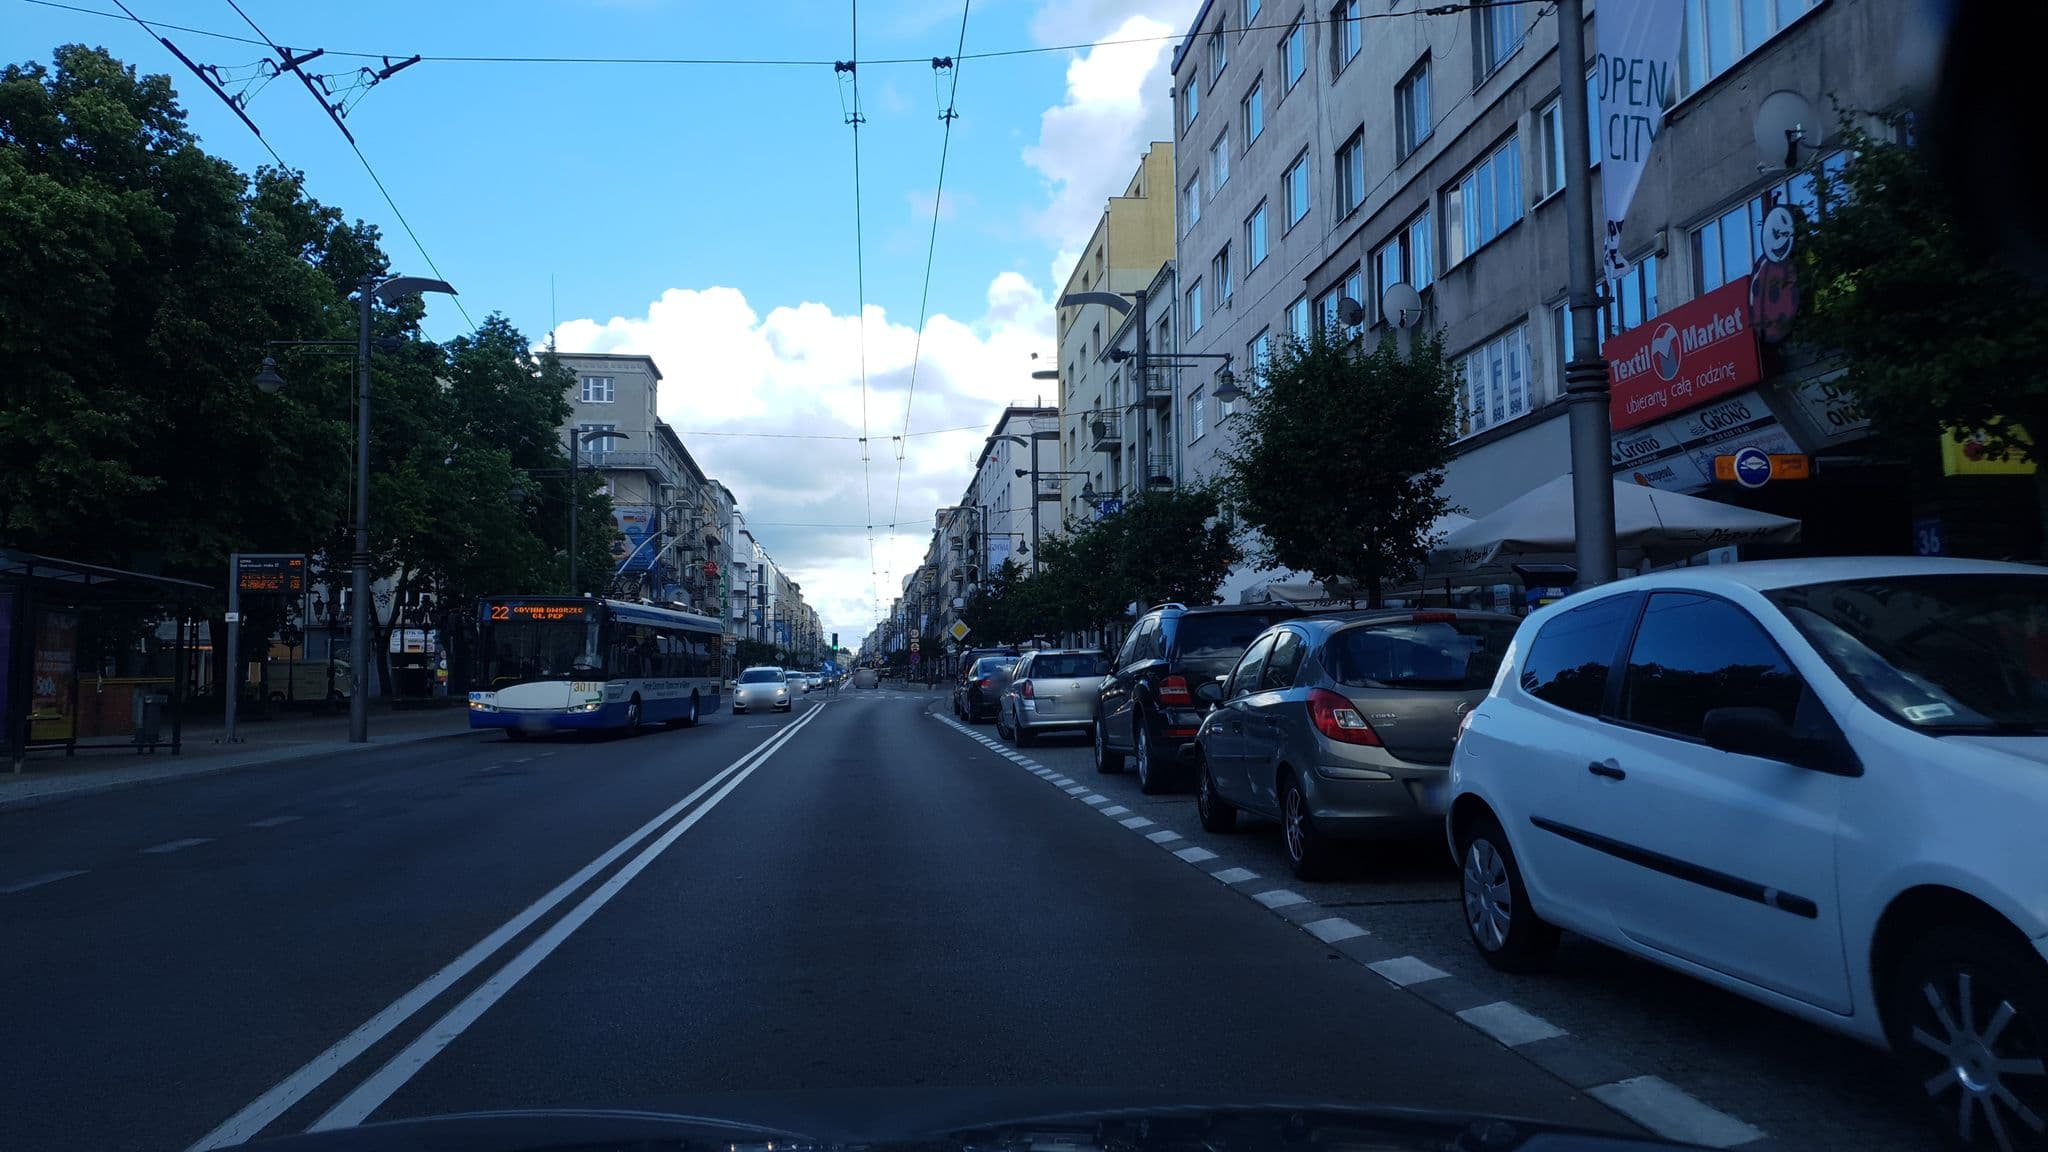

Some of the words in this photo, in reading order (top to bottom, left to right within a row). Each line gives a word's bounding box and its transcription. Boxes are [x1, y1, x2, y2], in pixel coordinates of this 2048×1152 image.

[1599, 54, 1666, 108] OPEN
[1609, 114, 1656, 162] CITY
[1611, 345, 1651, 383] Textil
[1682, 307, 1744, 354] Market
[1625, 387, 1668, 415] ubieramy
[1671, 378, 1693, 397] całą
[1696, 361, 1737, 388] rodzinę
[1700, 406, 1752, 431] GRONO
[1616, 437, 1660, 459] Grono
[1919, 528, 1941, 555] 36
[491, 606, 510, 620] 22
